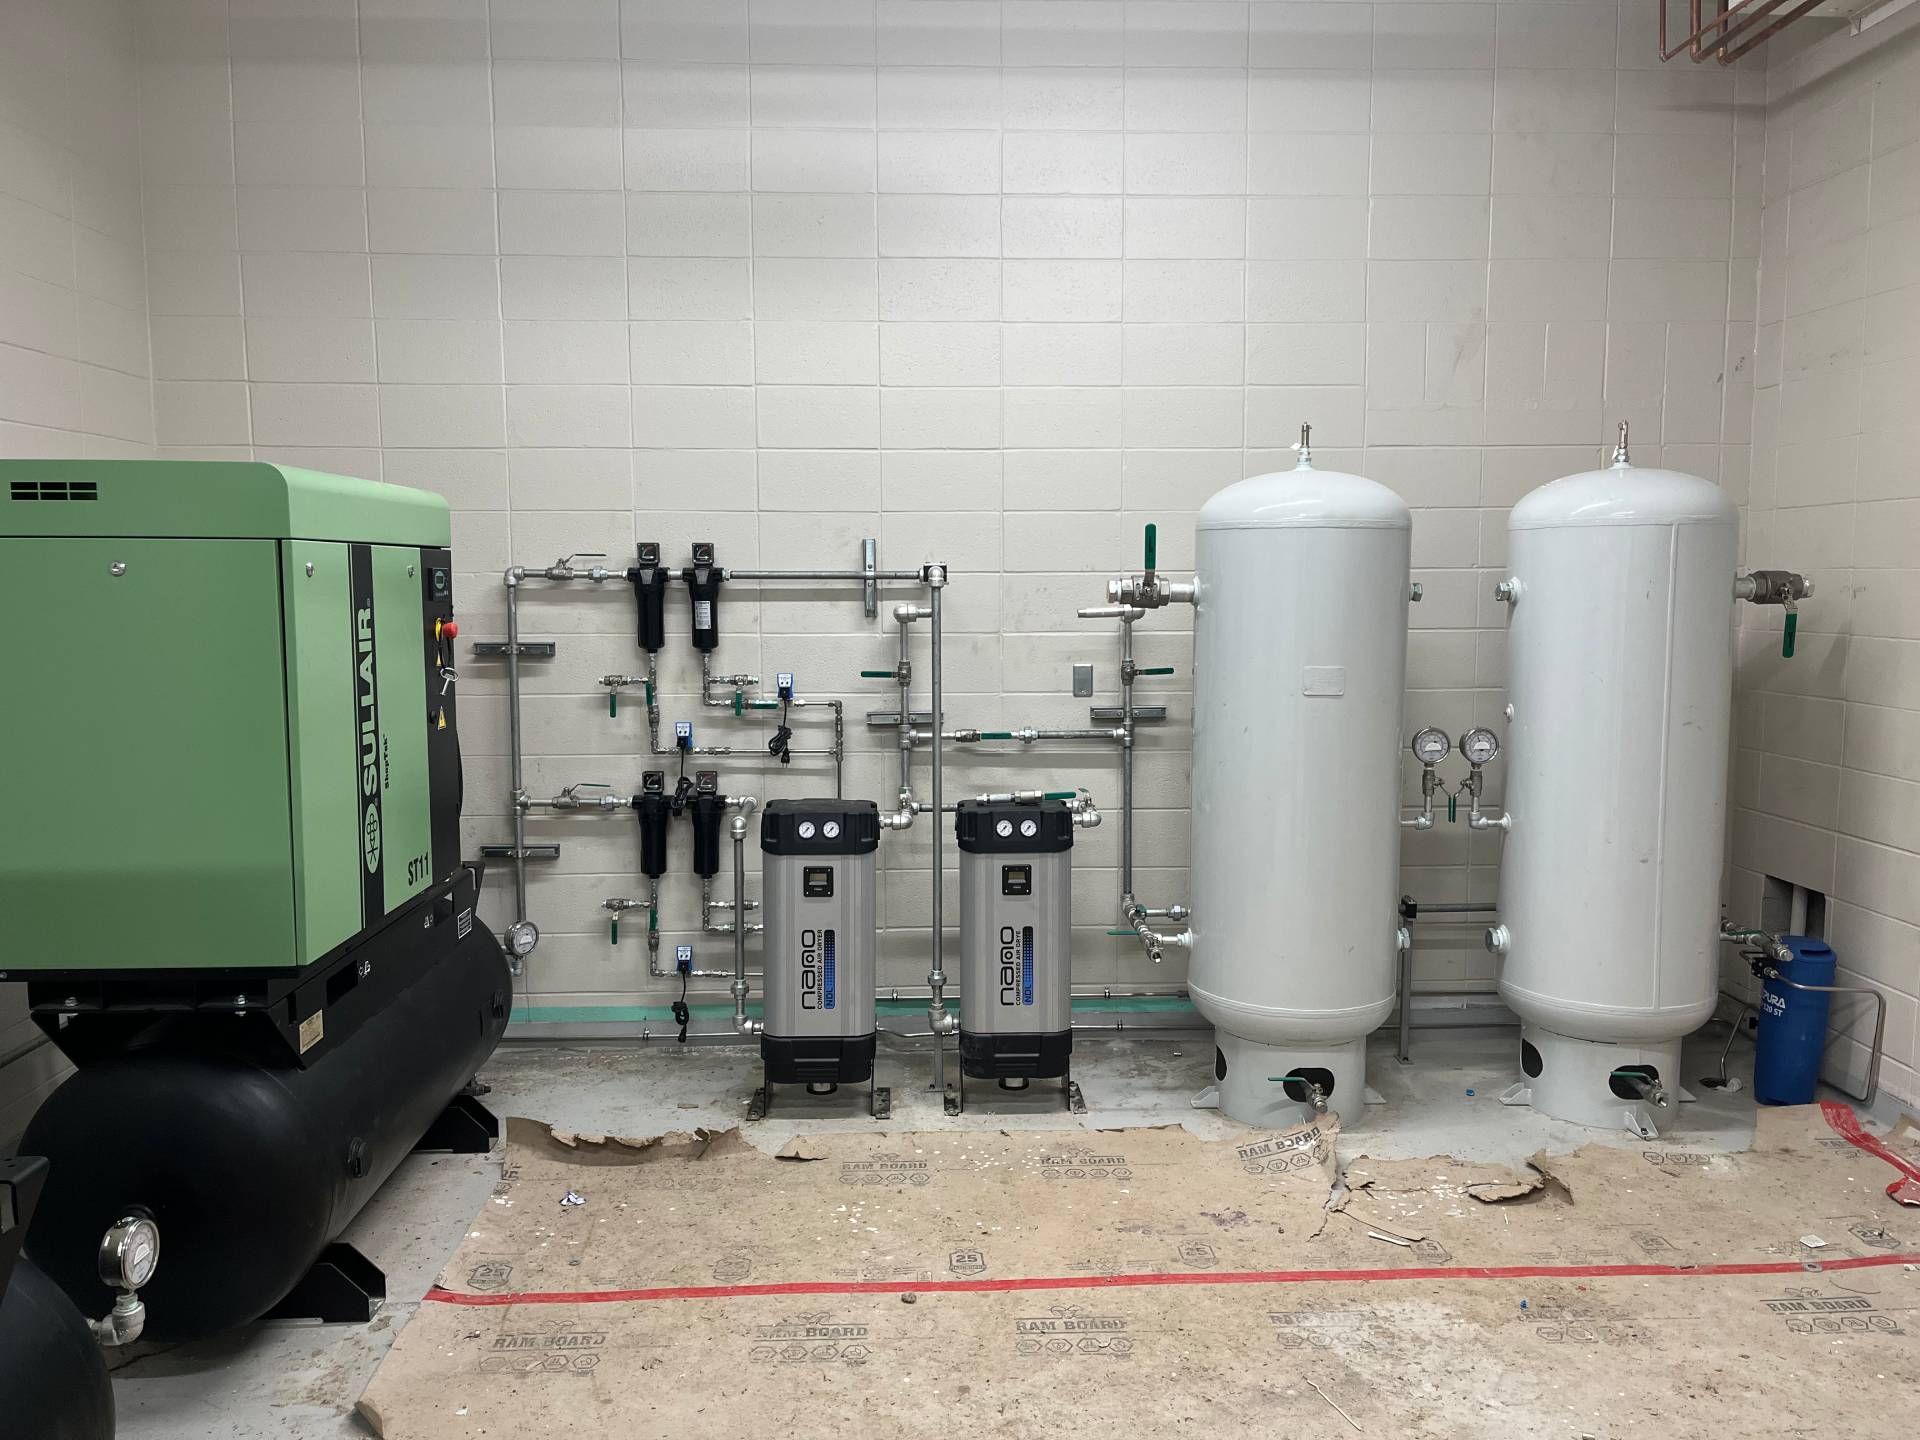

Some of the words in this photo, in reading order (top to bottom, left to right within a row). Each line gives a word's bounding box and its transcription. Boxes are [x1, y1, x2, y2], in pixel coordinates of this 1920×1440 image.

[357, 607, 378, 797] SULLAIR
[408, 852, 429, 886] ST11
[801, 929, 816, 1010] nano
[1000, 926, 1014, 1006] nano
[1024, 983, 1032, 1003] NDL
[1773, 1008, 1783, 1017] ST
[1238, 1143, 1271, 1159] RAM
[956, 1254, 977, 1263] 25
[1767, 1302, 1809, 1312] RAM
[1810, 1299, 1873, 1311] BOARD
[1016, 1321, 1057, 1330] RAM
